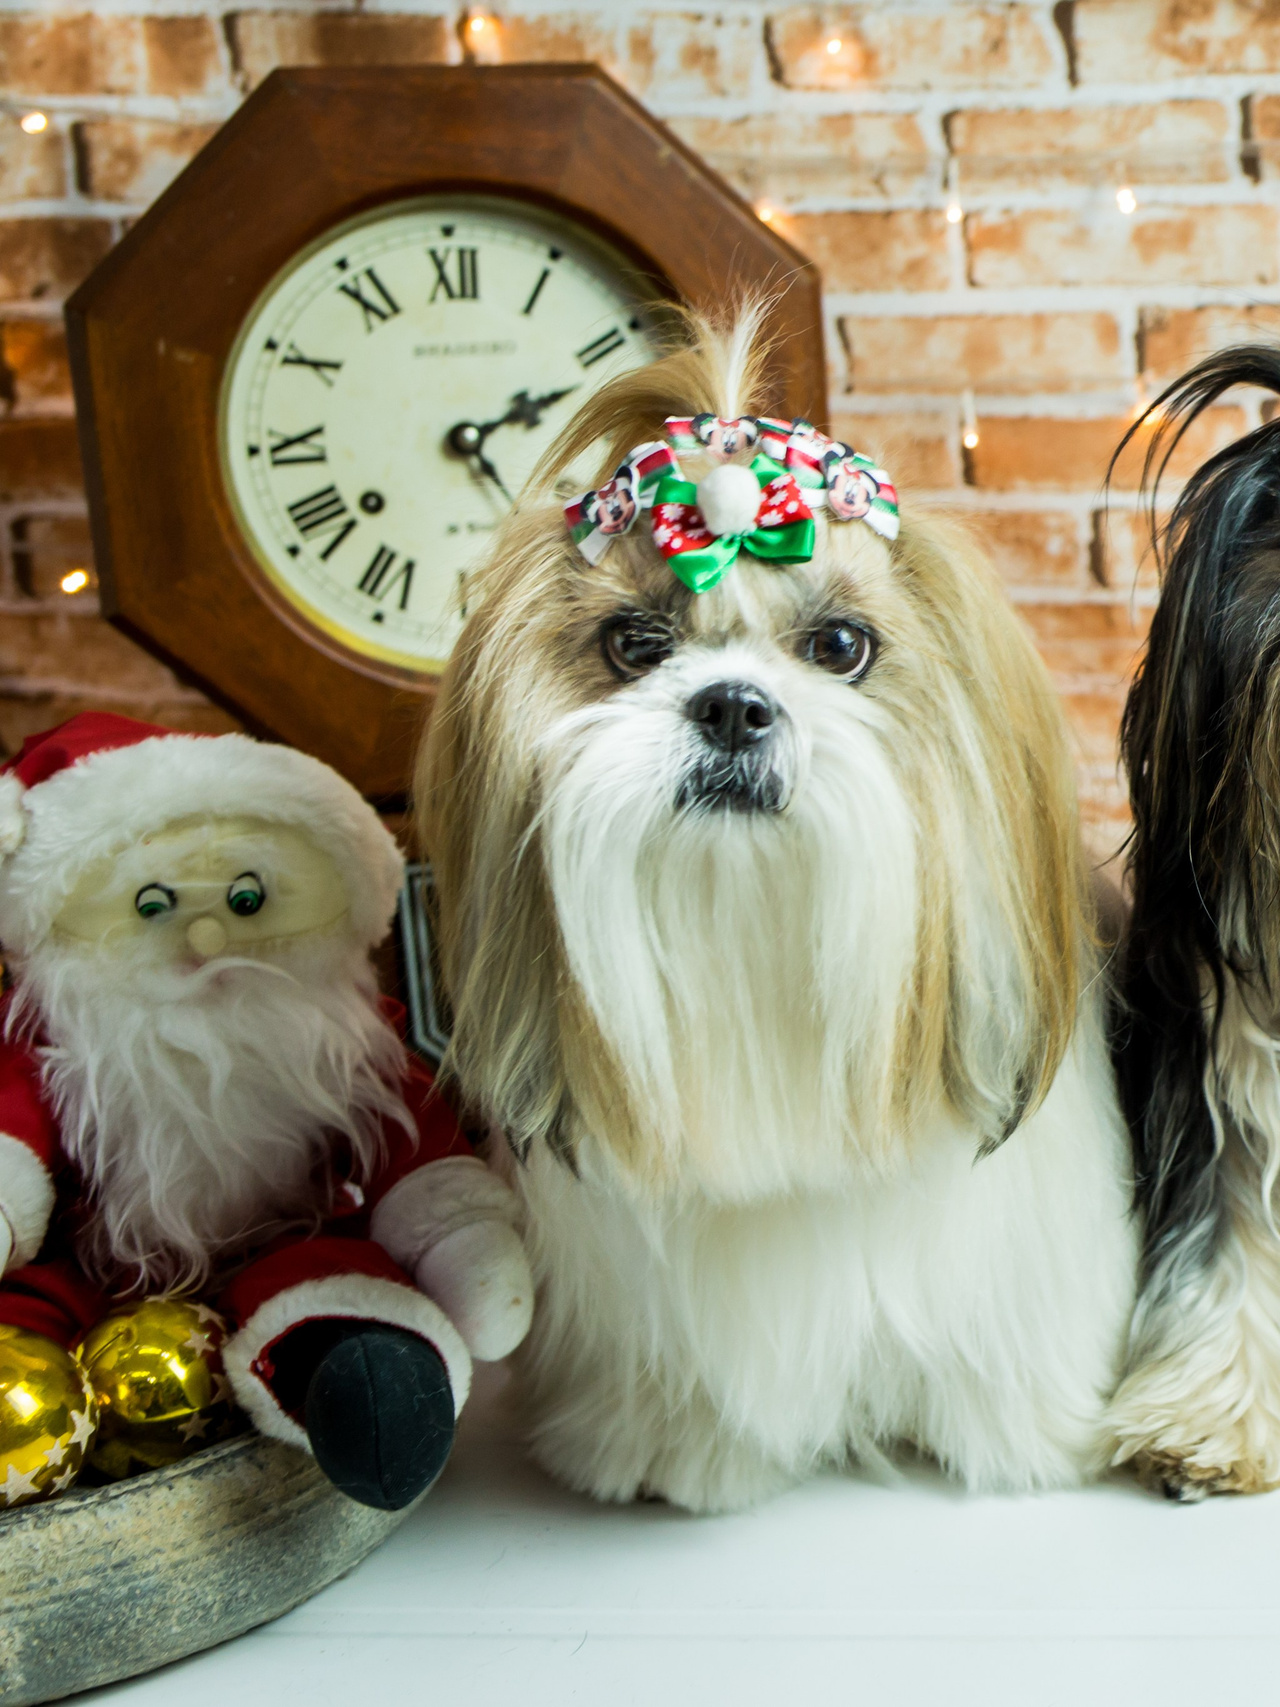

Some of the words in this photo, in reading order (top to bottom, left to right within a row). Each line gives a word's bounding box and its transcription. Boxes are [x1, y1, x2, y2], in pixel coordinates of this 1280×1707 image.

[339, 266, 401, 333] XI
[427, 246, 480, 304] XII
[279, 341, 343, 388] X
[575, 326, 627, 370] II
[268, 424, 328, 467] IX
[287, 485, 358, 563] VIII
[356, 543, 417, 612] VII
